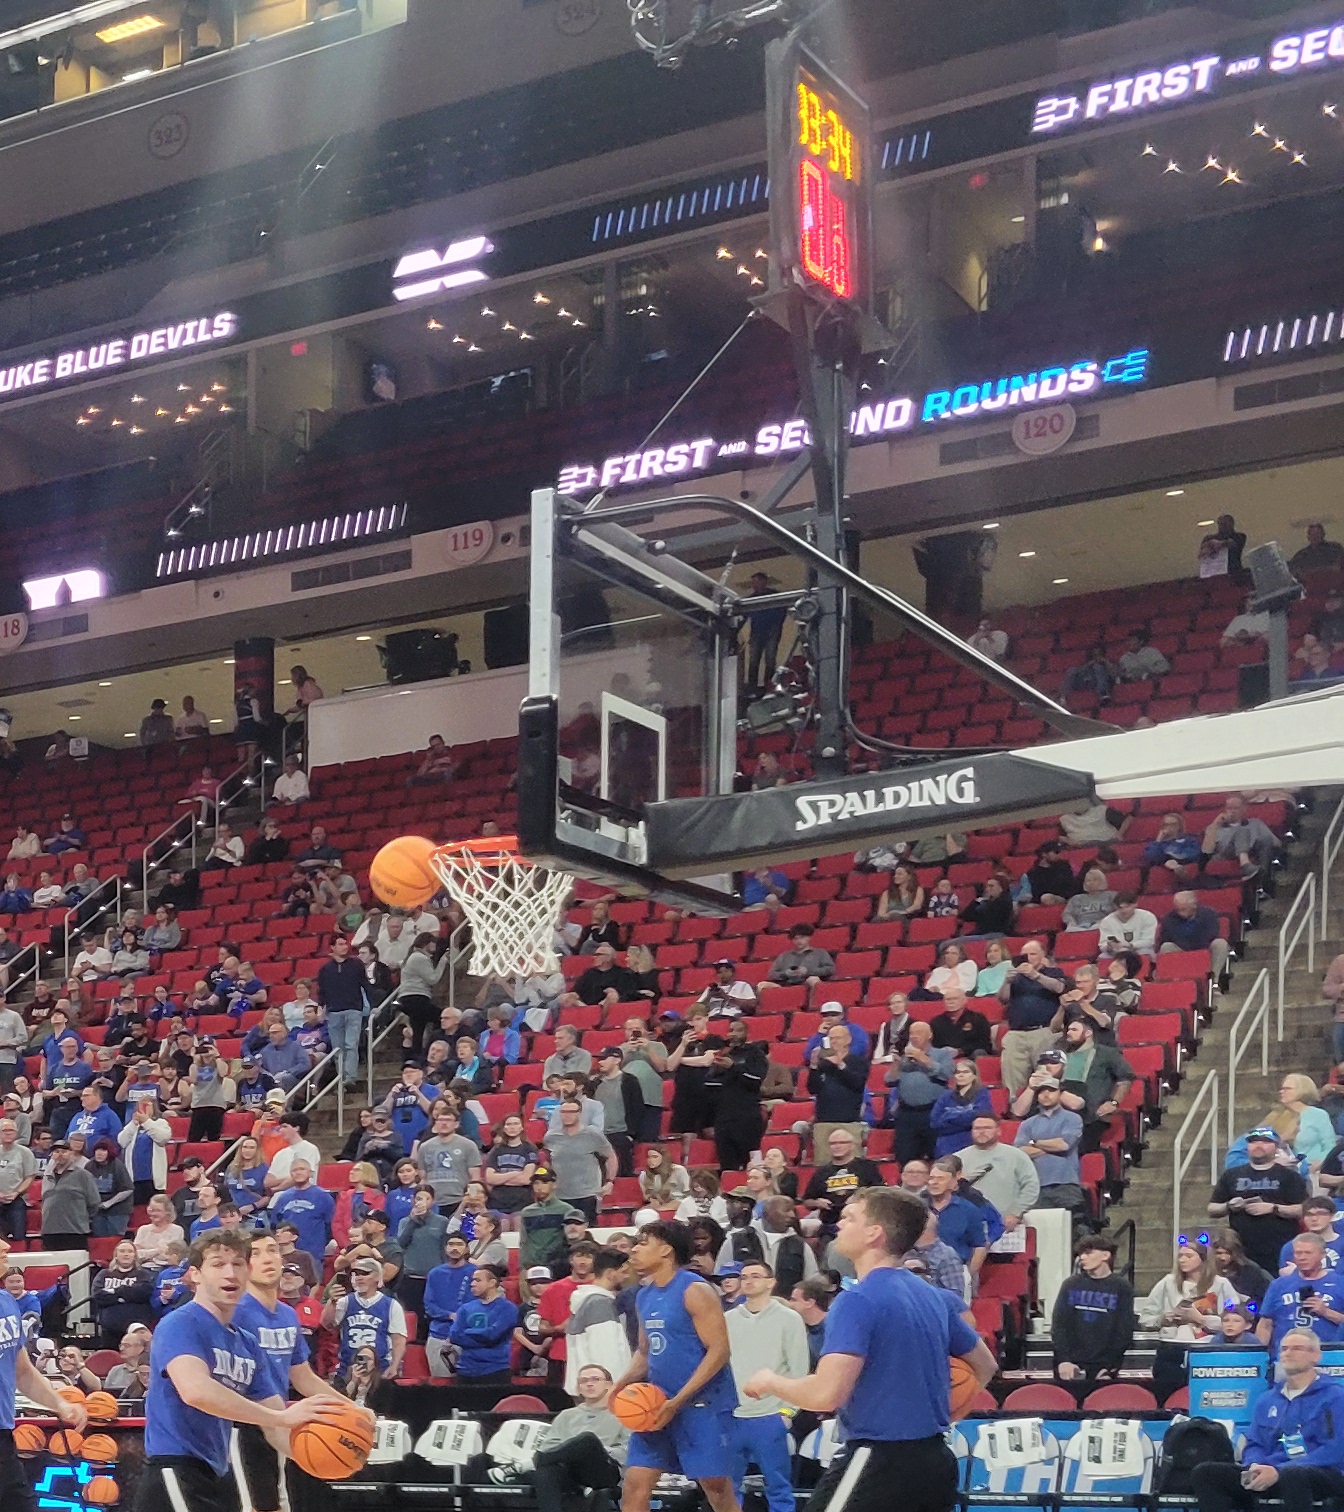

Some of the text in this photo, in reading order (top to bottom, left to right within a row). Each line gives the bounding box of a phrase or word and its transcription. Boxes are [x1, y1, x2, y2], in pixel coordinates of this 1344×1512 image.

[1085, 56, 1220, 119] FIRST
[1225, 57, 1261, 77] AND
[54, 340, 123, 380] BLUE
[129, 311, 235, 359] DEVILS
[600, 437, 713, 487] FIRST
[719, 441, 746, 456] AND
[922, 361, 1098, 422] ROUNDS
[1023, 412, 1065, 440] 120
[450, 527, 485, 552] 119
[795, 766, 980, 832] SPALDING
[1237, 1178, 1281, 1191] Duke
[105, 1277, 137, 1289] DUKE
[1069, 1290, 1118, 1309] DUKE
[347, 1314, 383, 1328] DUKE
[349, 1328, 378, 1349] 32
[1193, 1366, 1258, 1378] POWERADE
